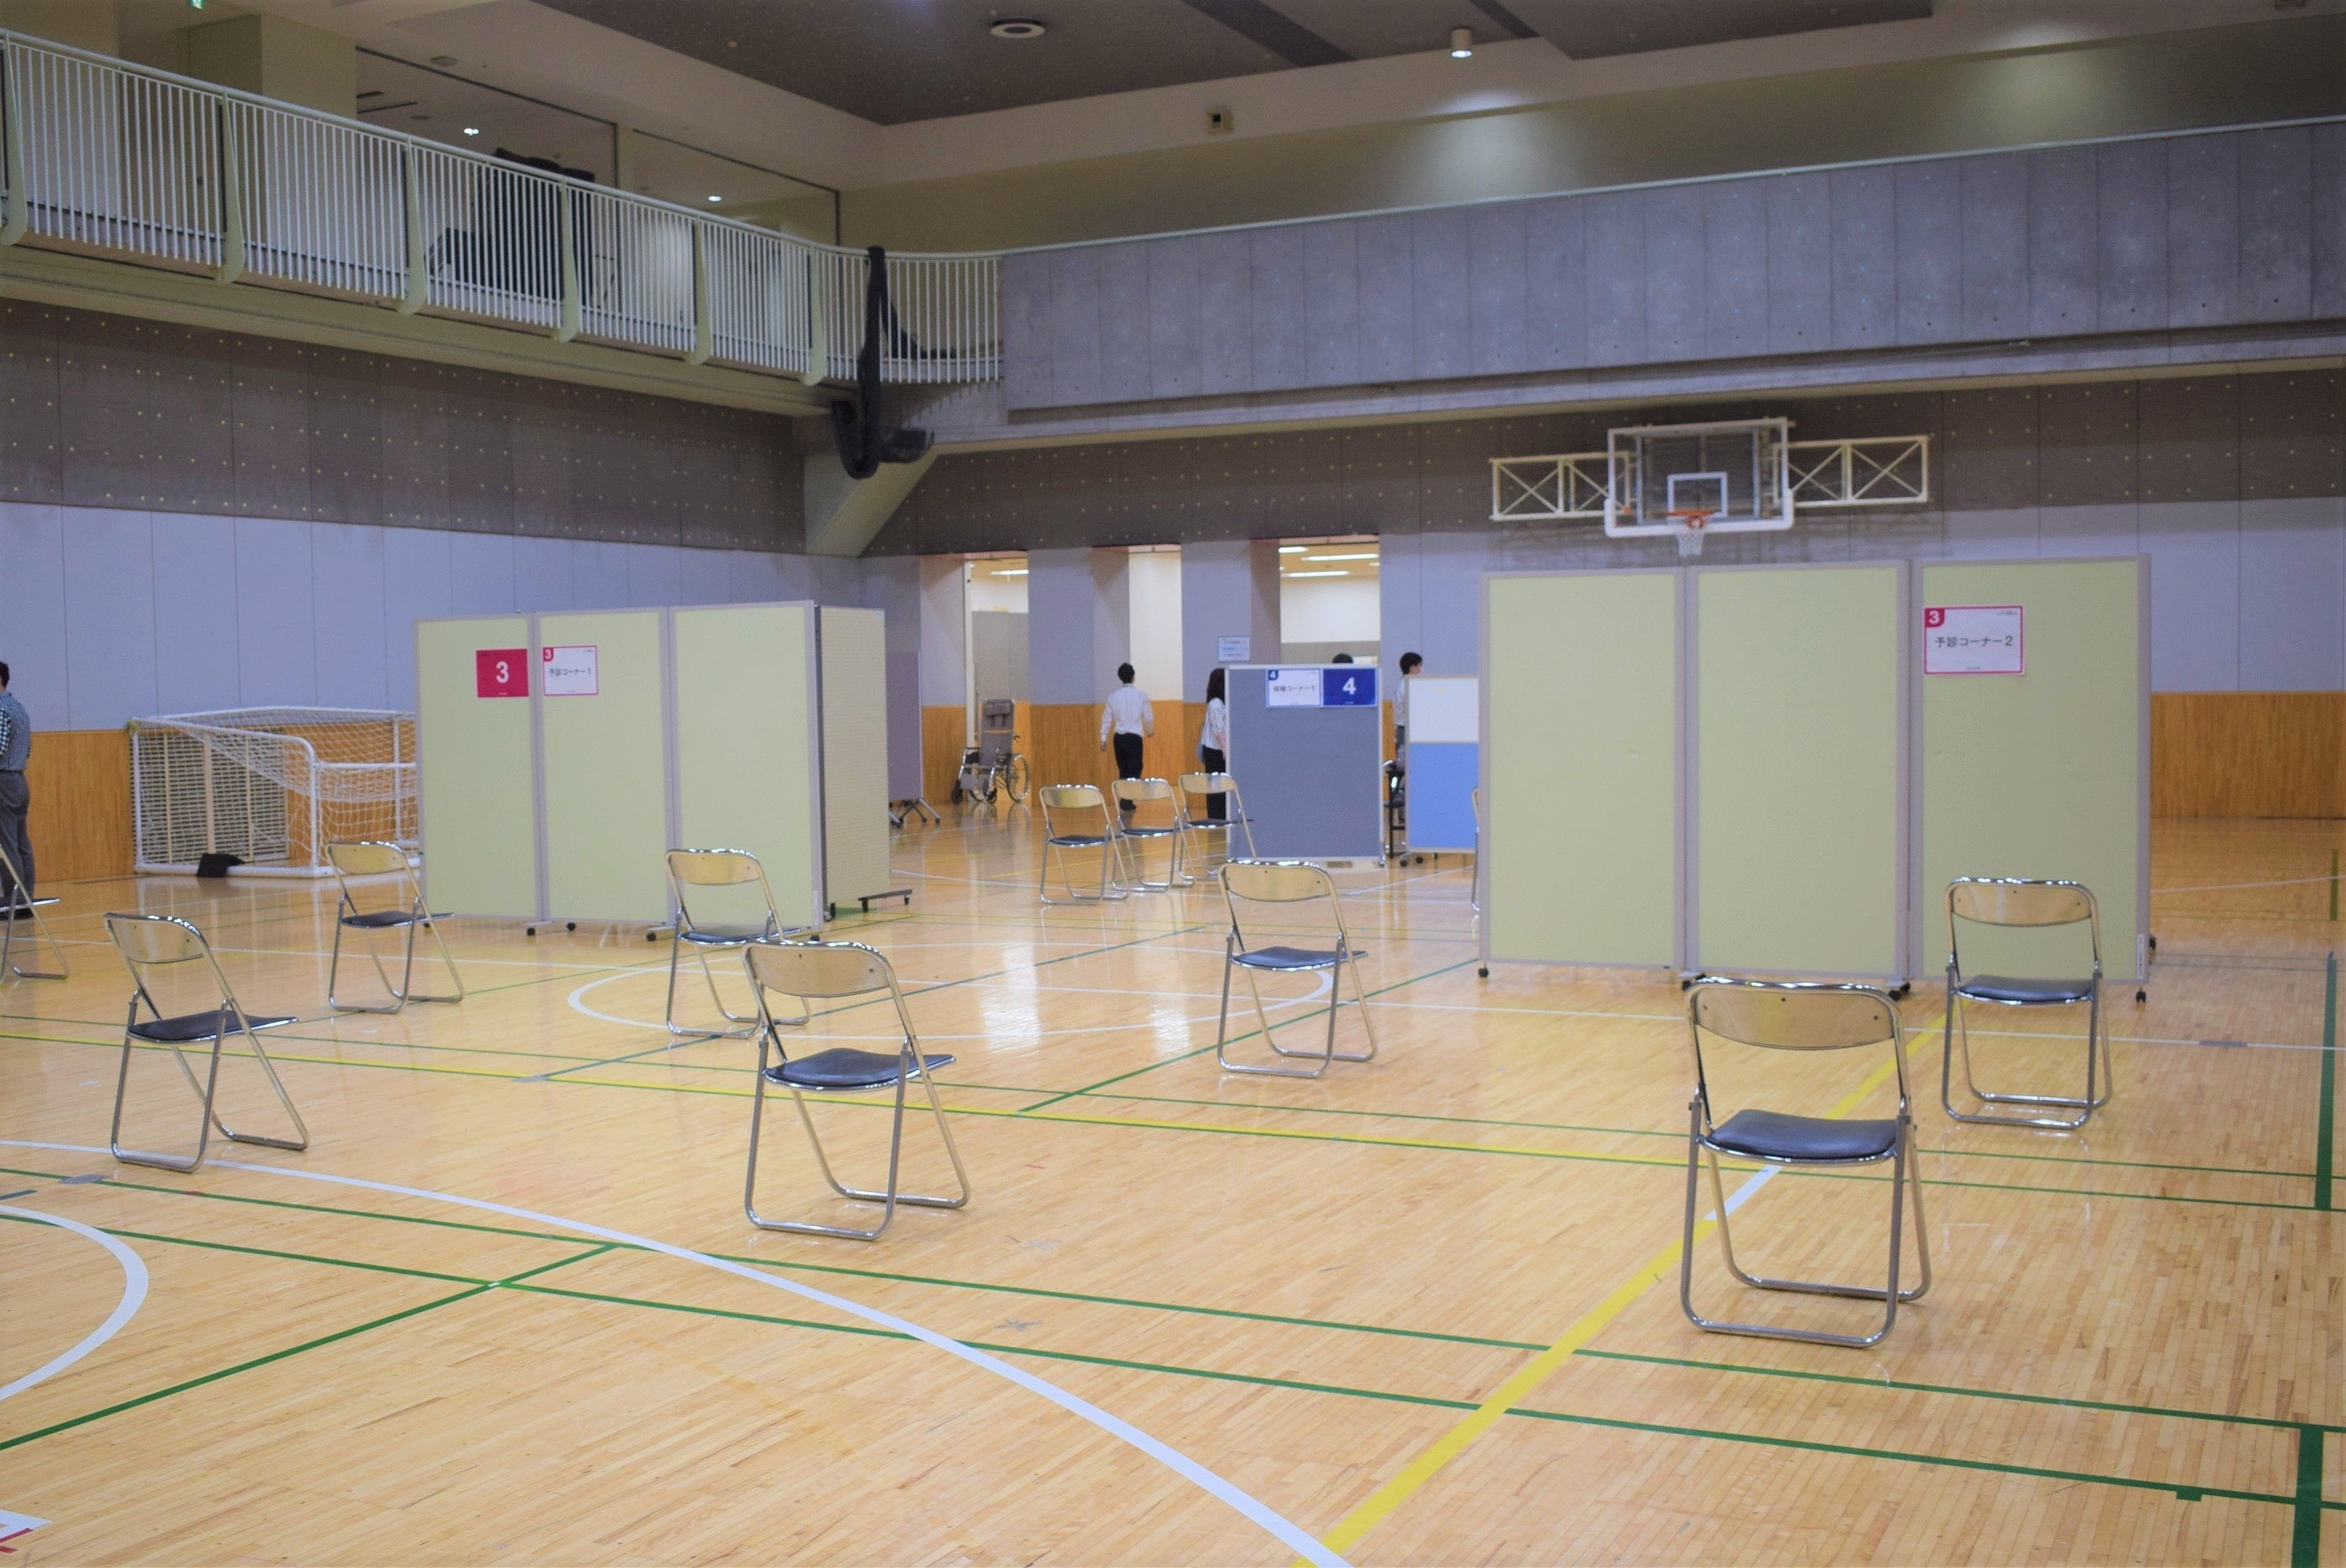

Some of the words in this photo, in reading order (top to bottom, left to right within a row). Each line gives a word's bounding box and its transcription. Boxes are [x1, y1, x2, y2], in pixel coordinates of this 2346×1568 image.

[1929, 610, 1940, 624] 3
[545, 649, 552, 660] 3
[496, 661, 510, 684] 3
[1269, 671, 1276, 679] 4
[1343, 677, 1356, 694] 4
